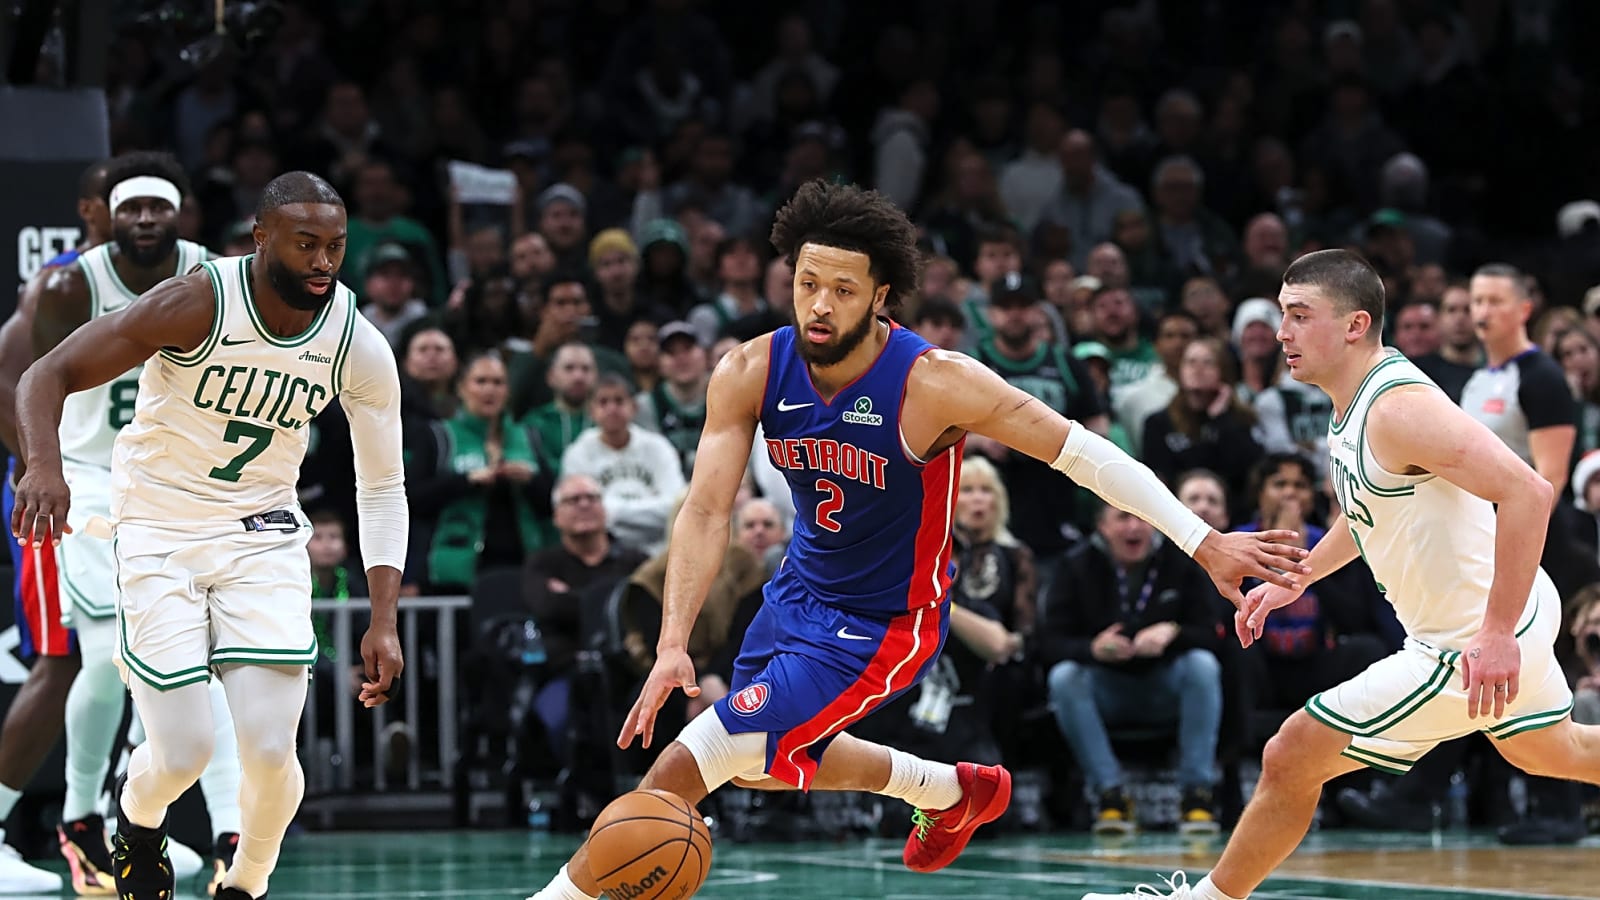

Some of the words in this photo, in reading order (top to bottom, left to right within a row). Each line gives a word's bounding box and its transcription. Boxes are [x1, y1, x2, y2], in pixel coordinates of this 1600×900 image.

[298, 350, 331, 364] Amica
[109, 379, 140, 431] 8
[193, 364, 326, 430] CELTICS
[844, 412, 881, 424] StockX
[208, 419, 275, 483] 7
[764, 438, 889, 490] DETROIT
[815, 478, 845, 533] 2
